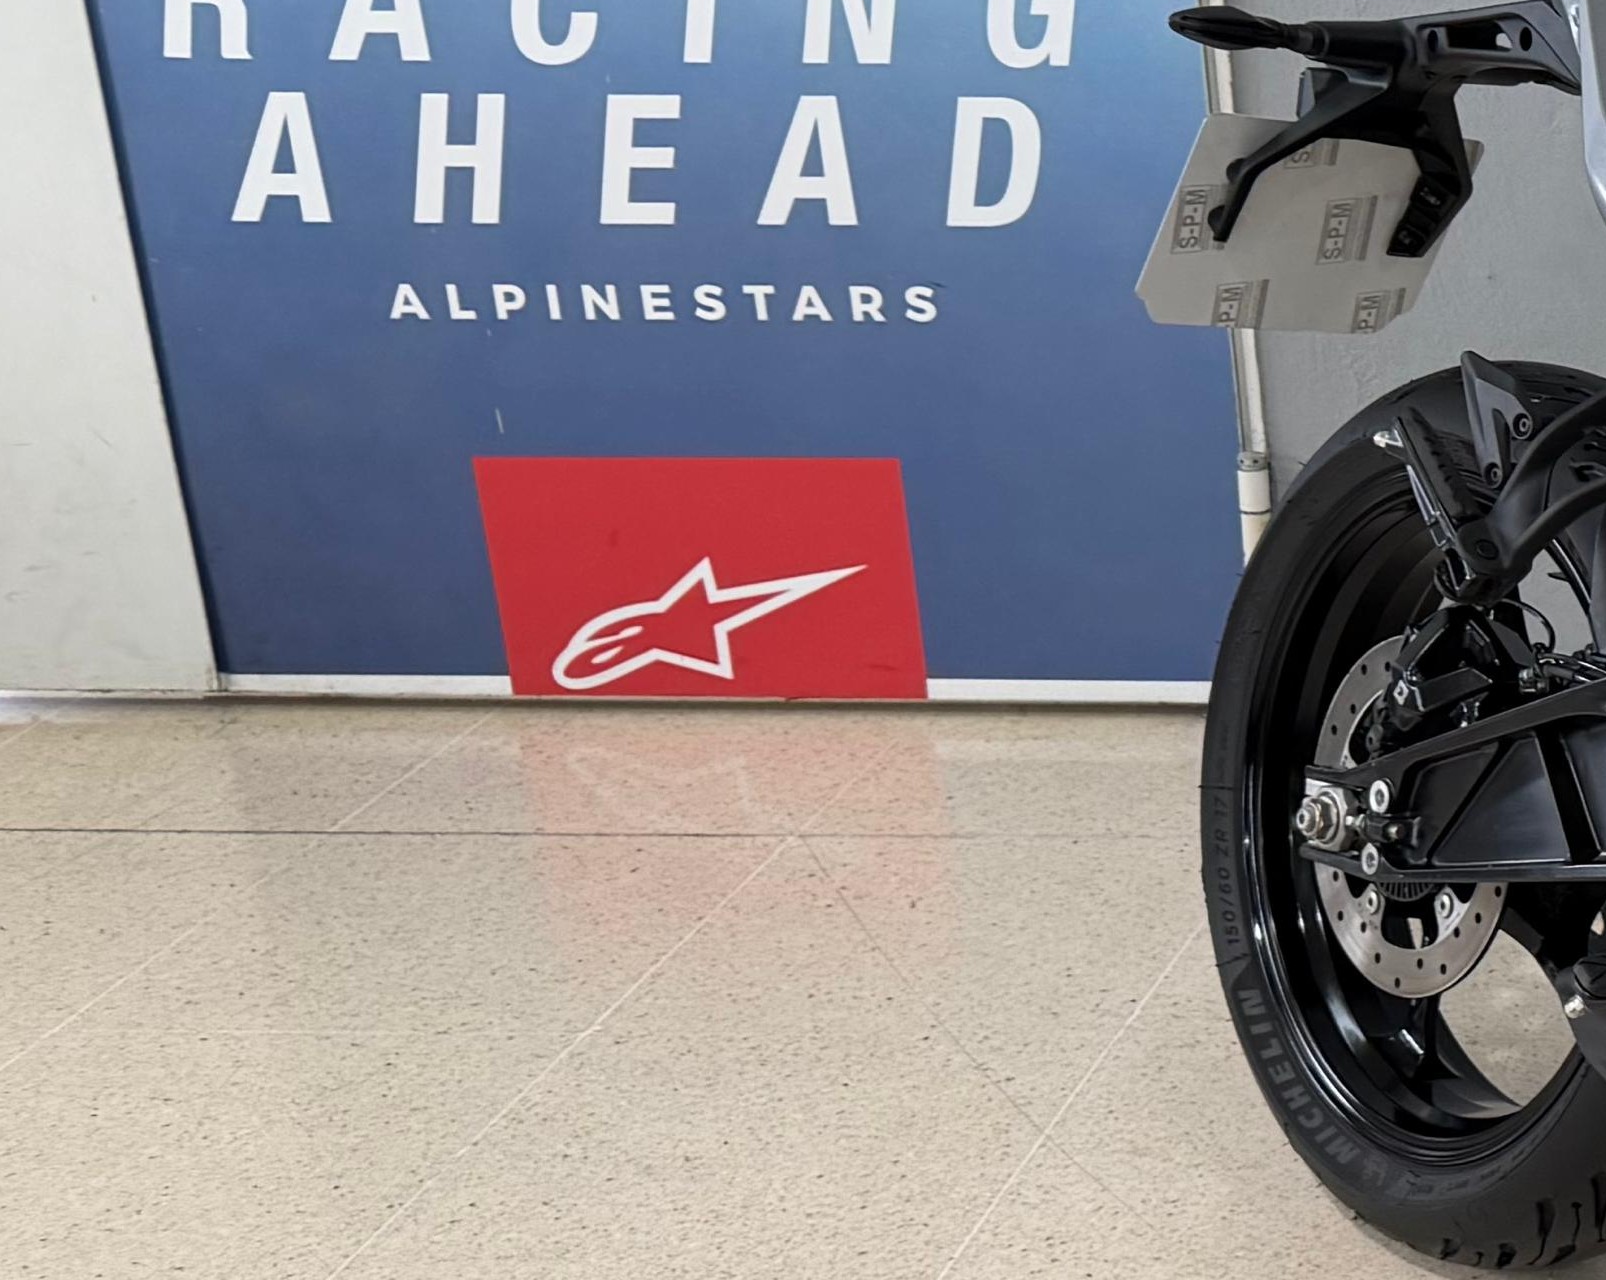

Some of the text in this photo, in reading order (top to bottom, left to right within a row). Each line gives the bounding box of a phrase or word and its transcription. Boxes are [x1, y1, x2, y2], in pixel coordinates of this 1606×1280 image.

[230, 91, 1043, 228] AHEAD
[389, 282, 939, 323] ALPINESTARS
[1212, 795, 1228, 819] 17
[1213, 829, 1229, 857] ZR
[1210, 866, 1242, 946] 150/60
[1243, 987, 1362, 1170] MICHELIN
